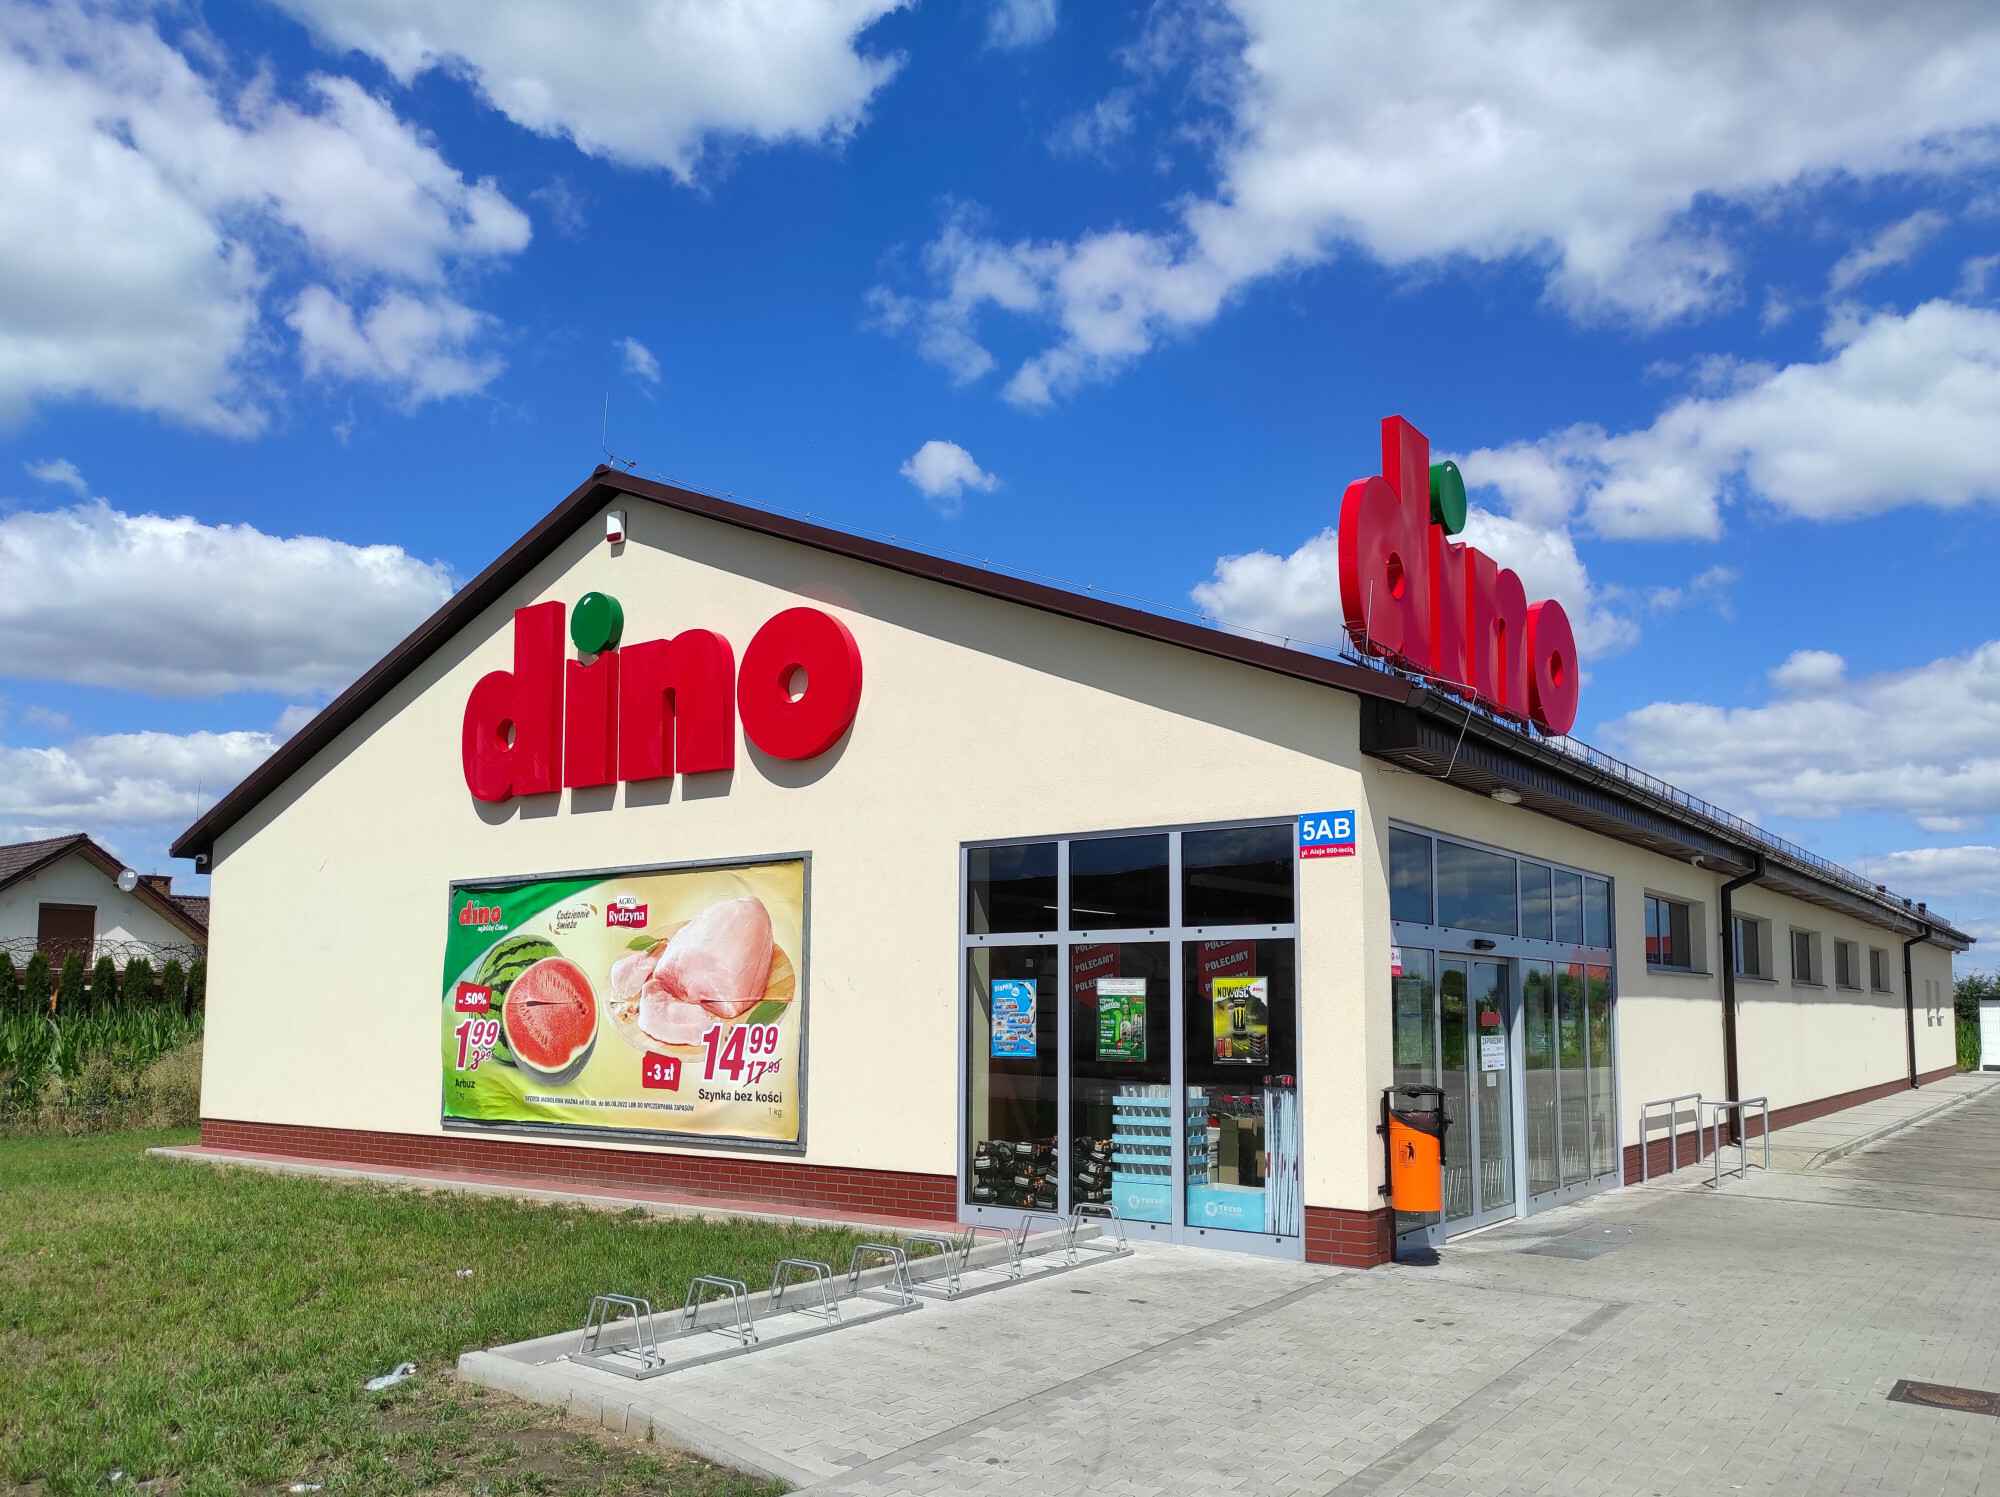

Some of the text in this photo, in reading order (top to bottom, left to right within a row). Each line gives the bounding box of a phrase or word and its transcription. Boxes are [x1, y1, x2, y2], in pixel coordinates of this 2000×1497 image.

[1338, 415, 1578, 736] dino
[462, 592, 862, 803] dino
[1303, 818, 1351, 840] 5AB
[459, 900, 502, 925] dino
[608, 910, 645, 923] Rydzyna
[1075, 953, 1114, 973] POLECAMY
[1205, 950, 1249, 972] POLECAMY
[455, 1078, 476, 1089] Arbuz
[698, 1088, 783, 1103] Szynka bez kości
